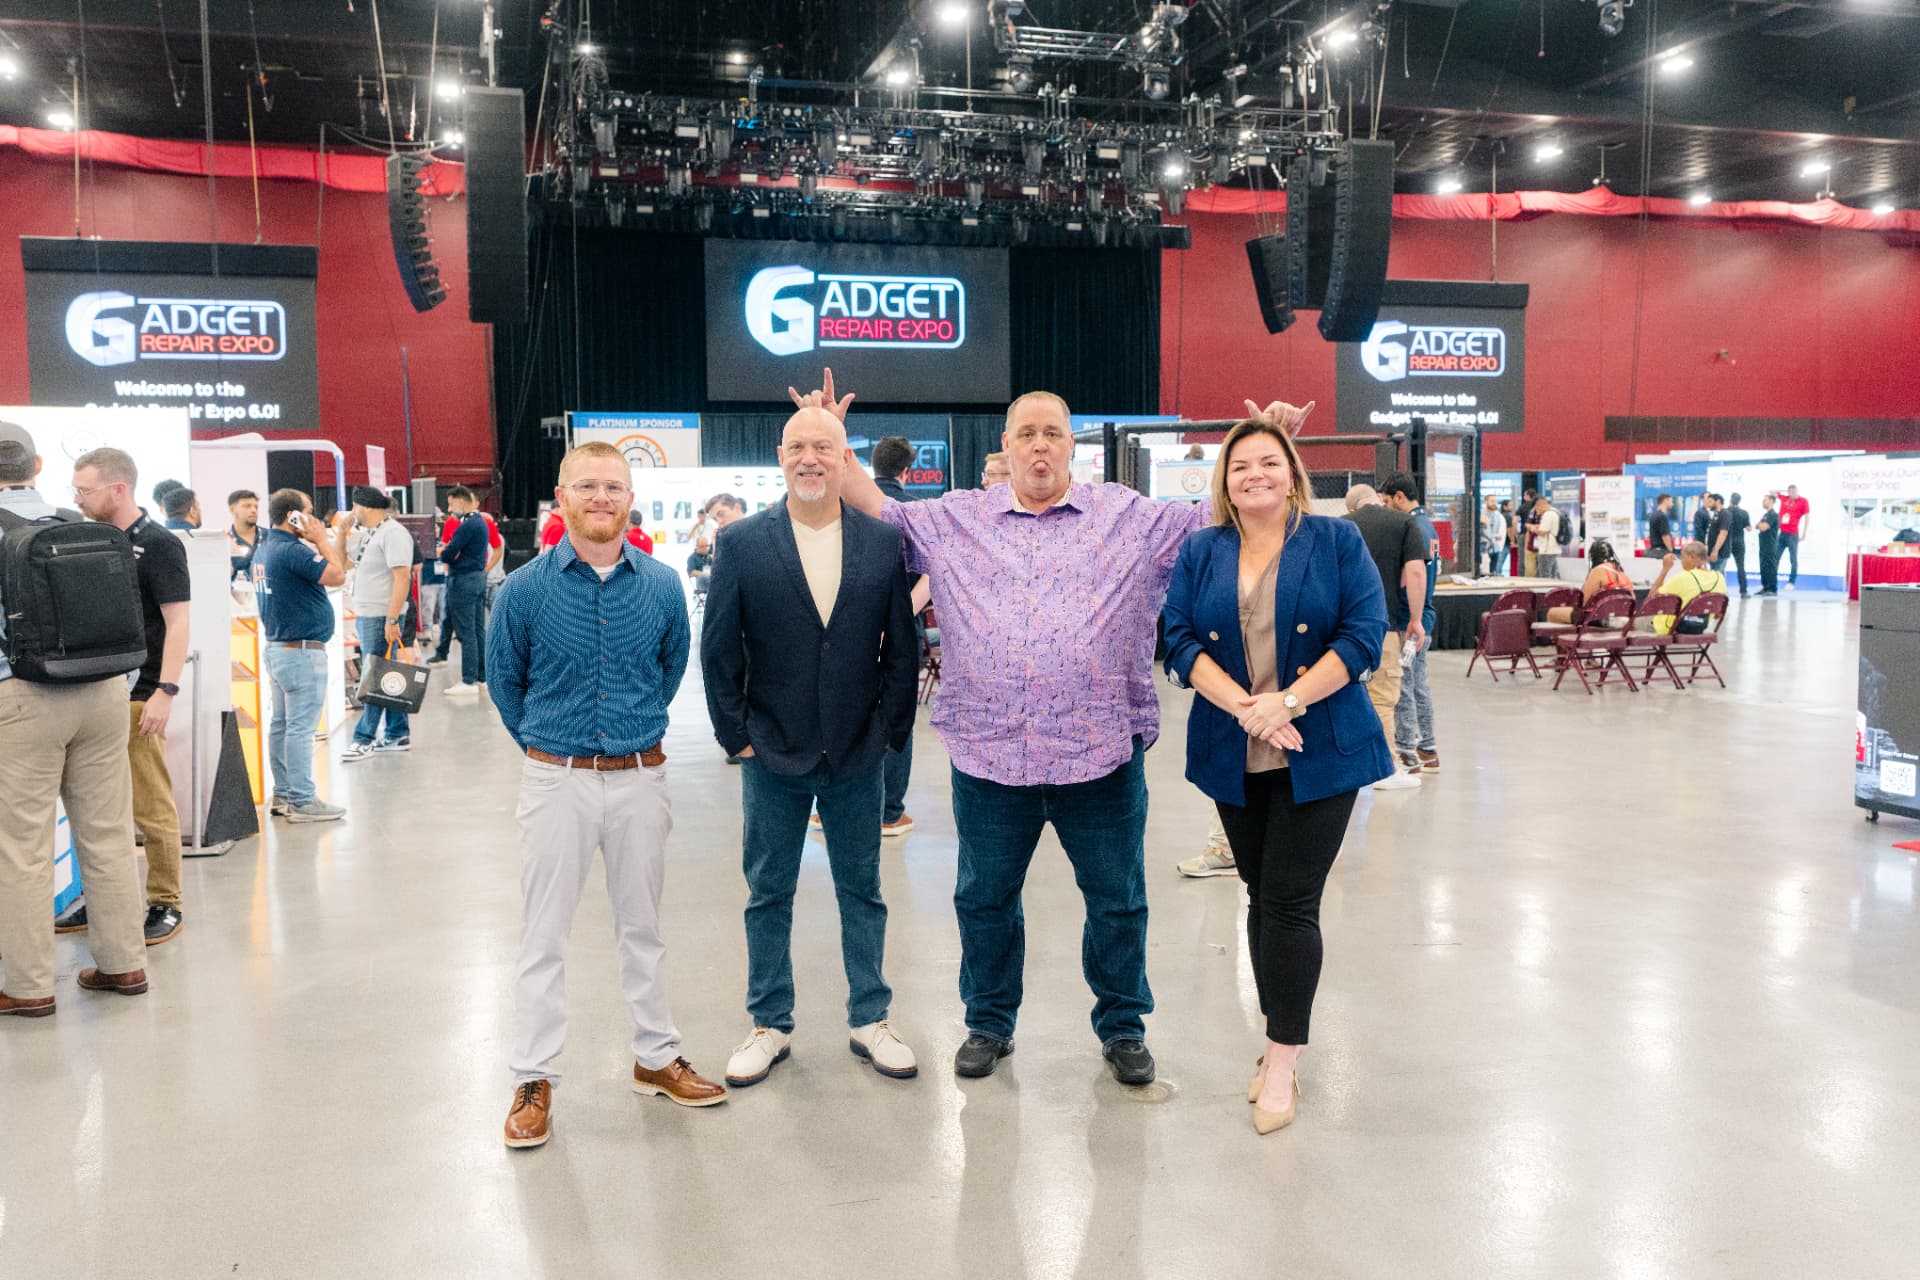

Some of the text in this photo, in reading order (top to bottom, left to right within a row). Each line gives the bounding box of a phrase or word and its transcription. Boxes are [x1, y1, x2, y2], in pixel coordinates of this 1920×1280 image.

[820, 317, 953, 341] REPAIR EXPO
[141, 333, 275, 354] REPAIR EXPO
[1409, 355, 1498, 371] REPAIR EXPO
[114, 380, 245, 397] Welcome to the
[1391, 392, 1477, 406] Welcome to the
[205, 403, 245, 422] Expo
[248, 403, 280, 420] 6.0!
[1370, 411, 1412, 427] Gadget
[588, 418, 683, 428] PLATINUM SPONSOR
[913, 469, 944, 485] EXPO
